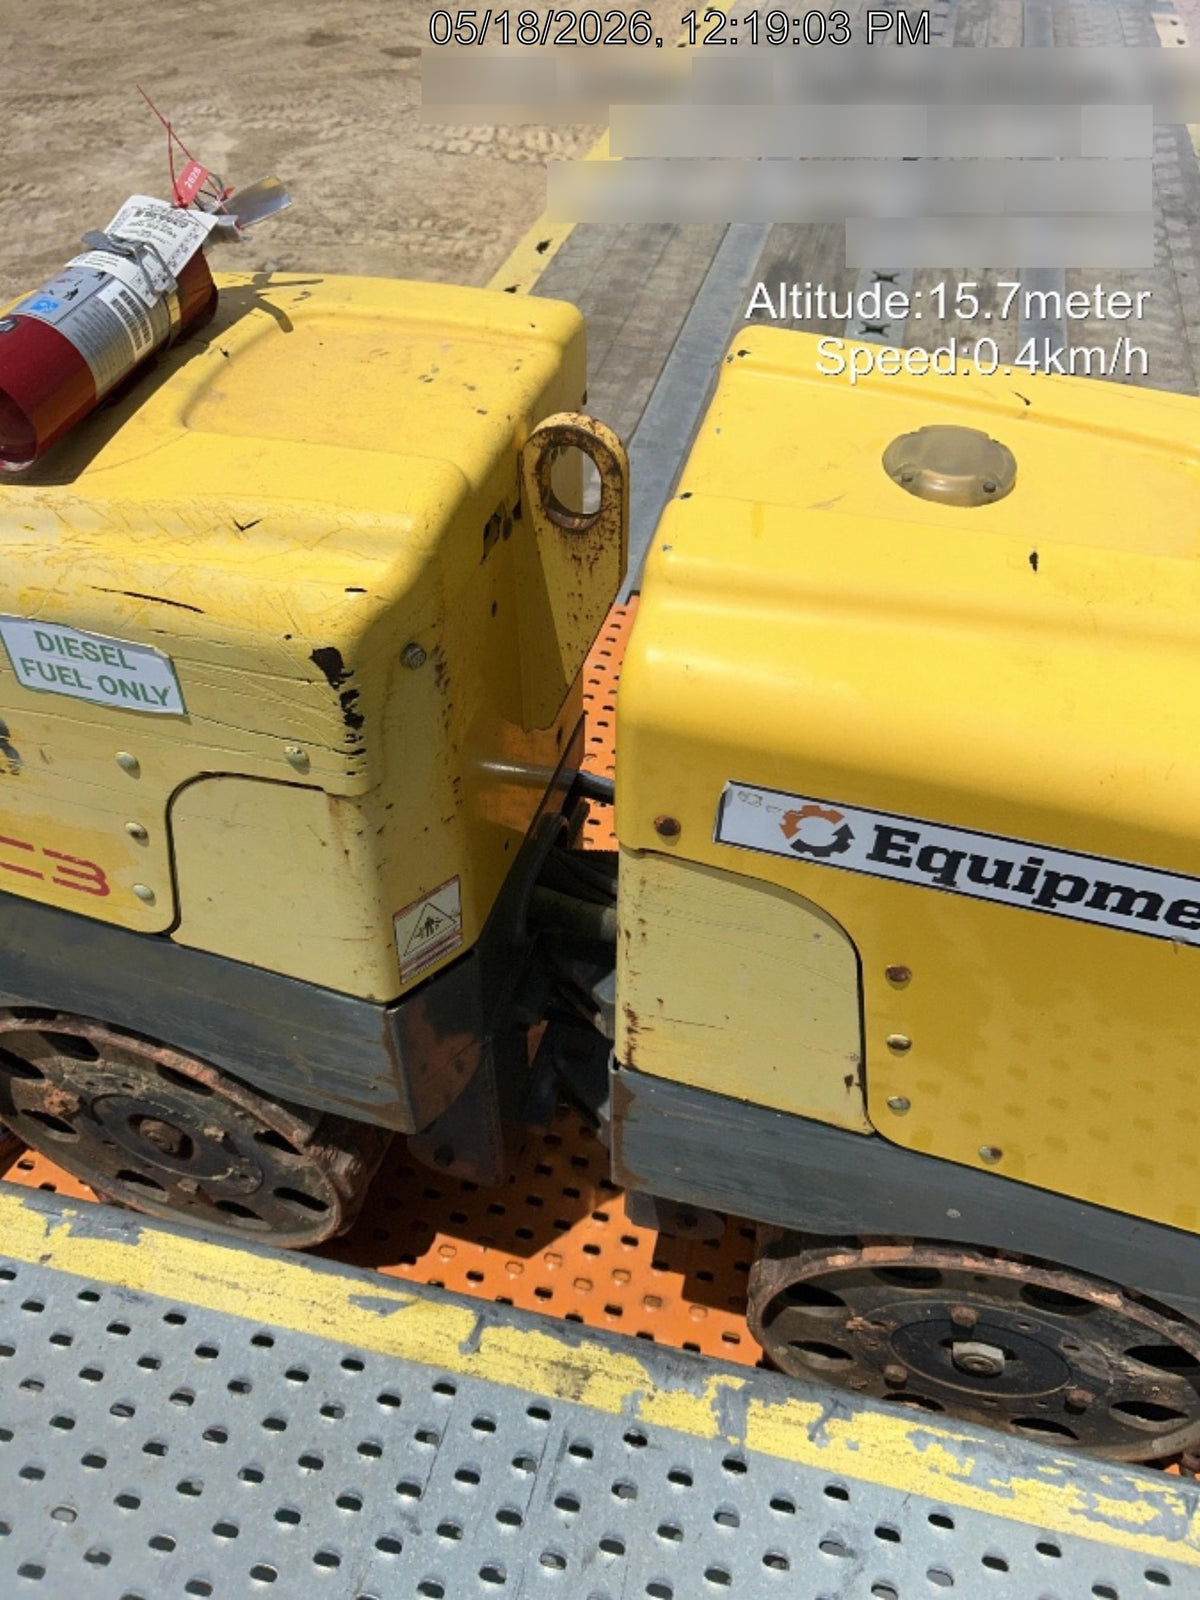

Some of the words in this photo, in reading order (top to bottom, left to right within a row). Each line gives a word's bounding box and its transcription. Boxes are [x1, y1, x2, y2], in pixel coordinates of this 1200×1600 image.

[34, 630, 137, 671] DIESEL
[20, 657, 92, 690] FUEL
[97, 674, 171, 706] ONLY
[865, 823, 1200, 930] Equipme
